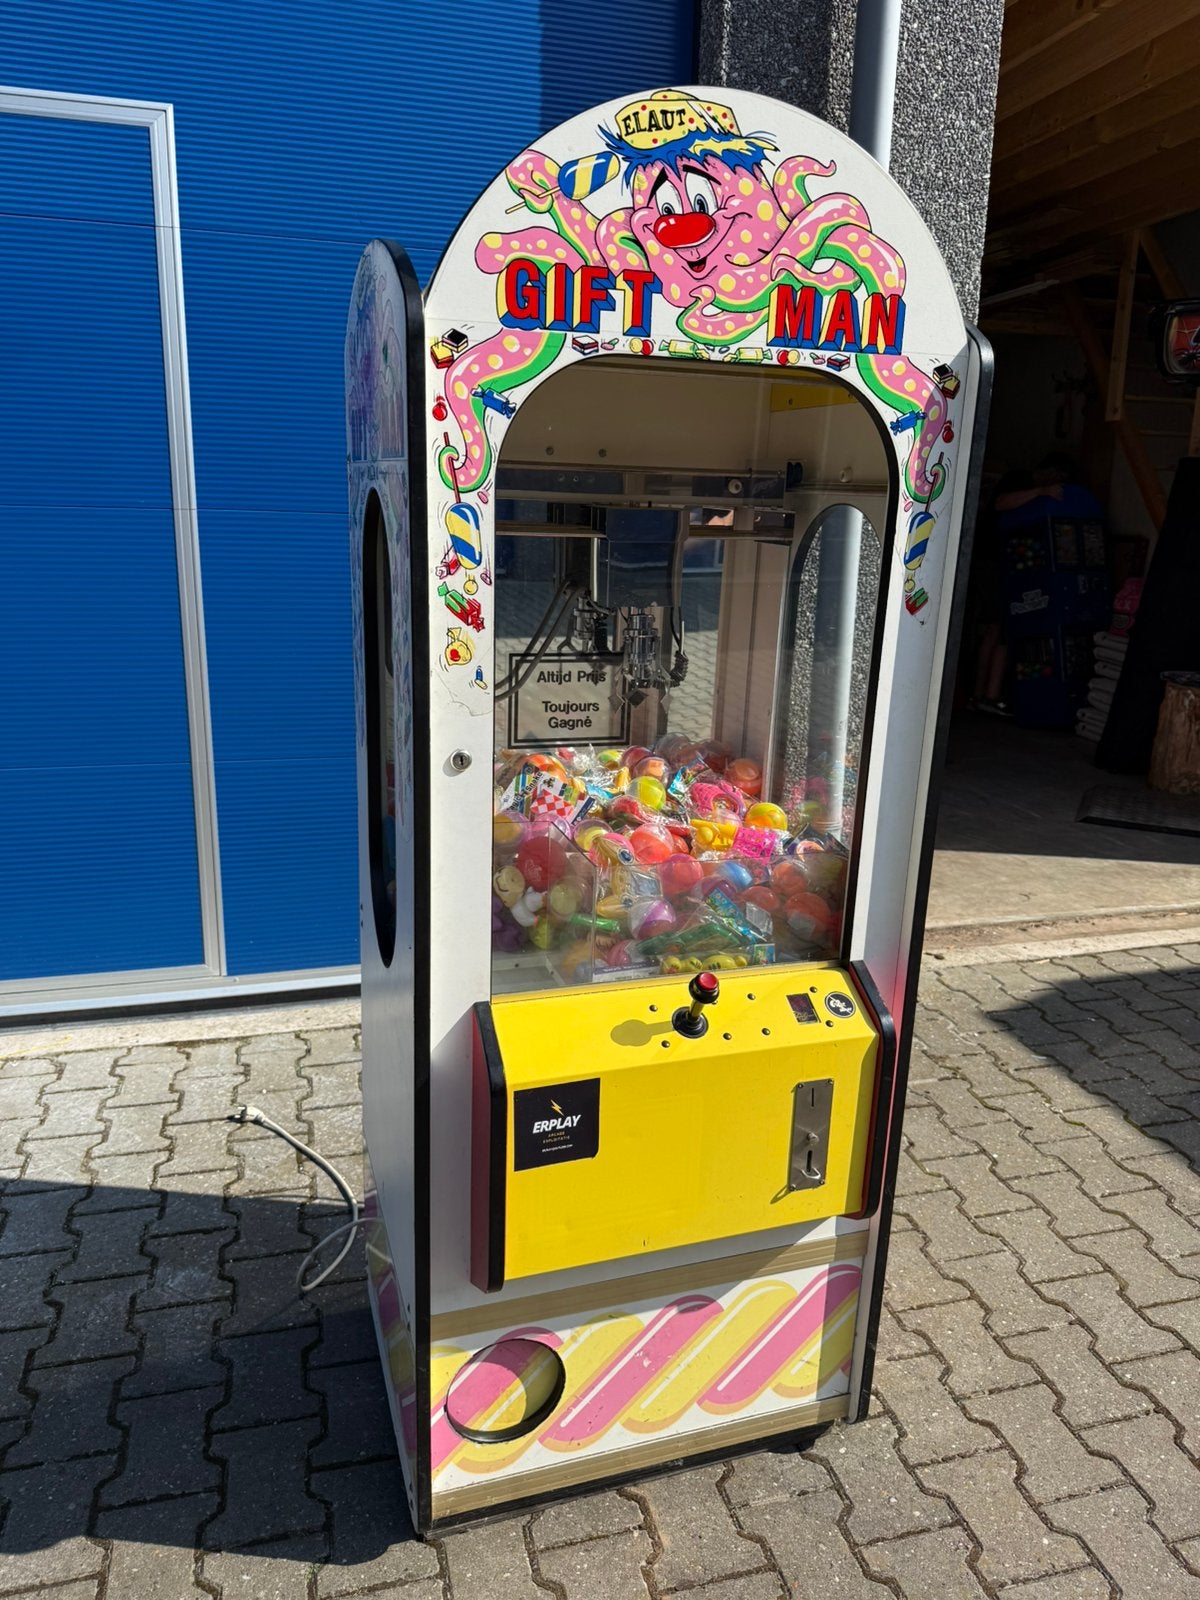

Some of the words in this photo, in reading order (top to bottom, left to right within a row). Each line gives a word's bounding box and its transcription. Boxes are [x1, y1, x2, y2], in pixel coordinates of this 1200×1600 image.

[621, 108, 686, 137] ELAUT
[496, 258, 663, 337] GIFT
[766, 284, 906, 355] MAN
[536, 670, 572, 685] Altijd
[577, 670, 607, 685] Prijs
[541, 700, 600, 715] Toujours
[547, 715, 592, 731] Gagné
[532, 1114, 582, 1135] ERPLAY
